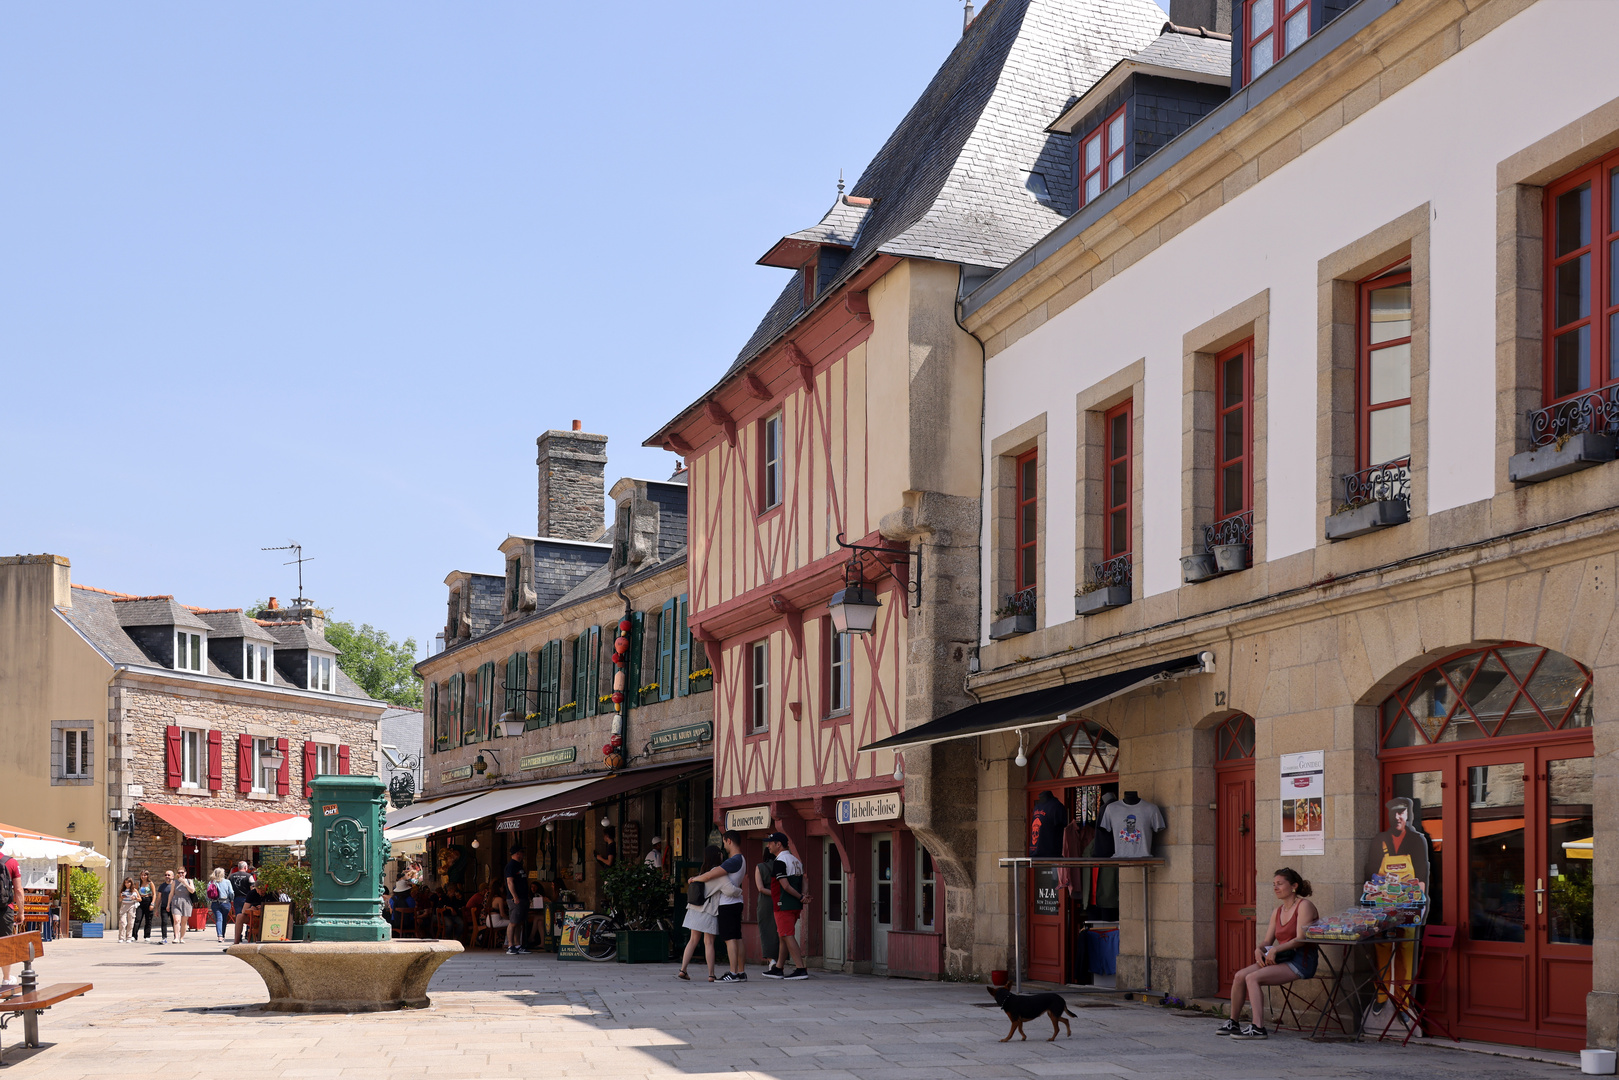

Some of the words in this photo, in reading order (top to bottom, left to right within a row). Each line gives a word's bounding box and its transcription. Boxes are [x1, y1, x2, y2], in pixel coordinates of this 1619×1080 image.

[1214, 691, 1226, 706] 12
[658, 734, 672, 743] MAISON
[852, 802, 858, 818] la
[858, 799, 896, 817] belle-iloise
[732, 814, 736, 827] la
[737, 812, 764, 826] conserverie
